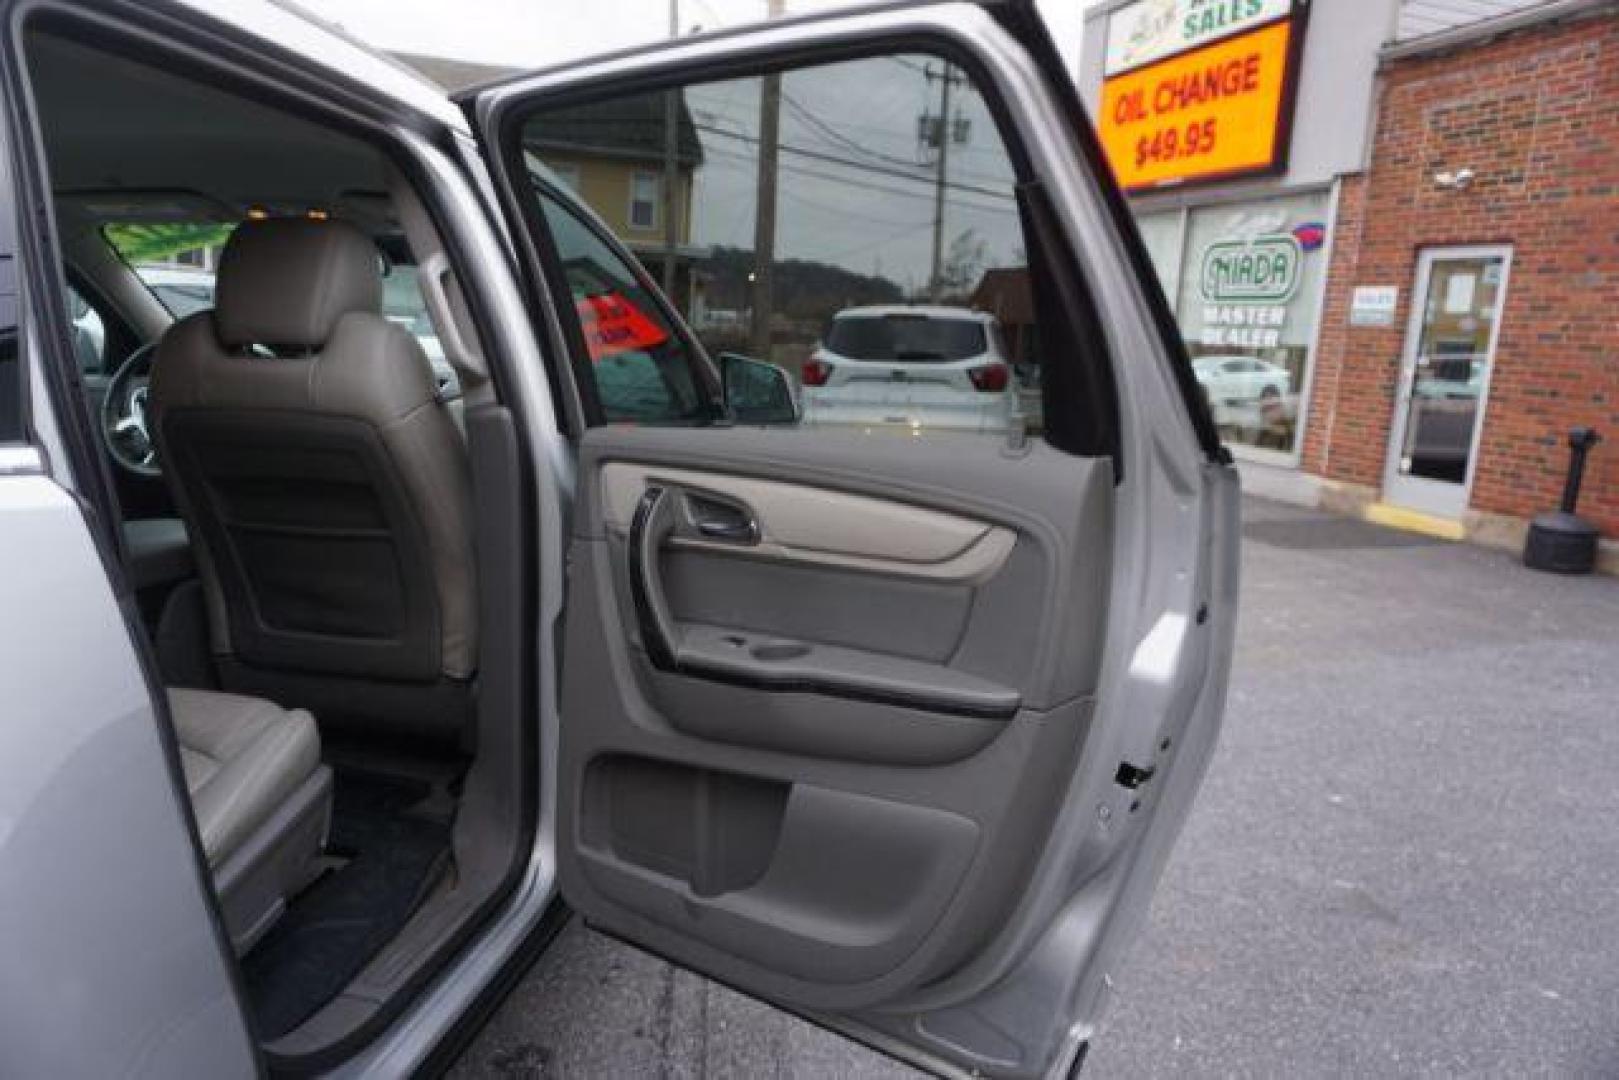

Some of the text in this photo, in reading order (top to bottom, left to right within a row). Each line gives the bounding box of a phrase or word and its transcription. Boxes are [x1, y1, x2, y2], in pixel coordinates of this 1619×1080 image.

[1183, 0, 1263, 39] SALES
[1114, 54, 1260, 125] OIL CHANGE
[1135, 118, 1217, 169] $49.95
[1210, 251, 1287, 285] NIADA
